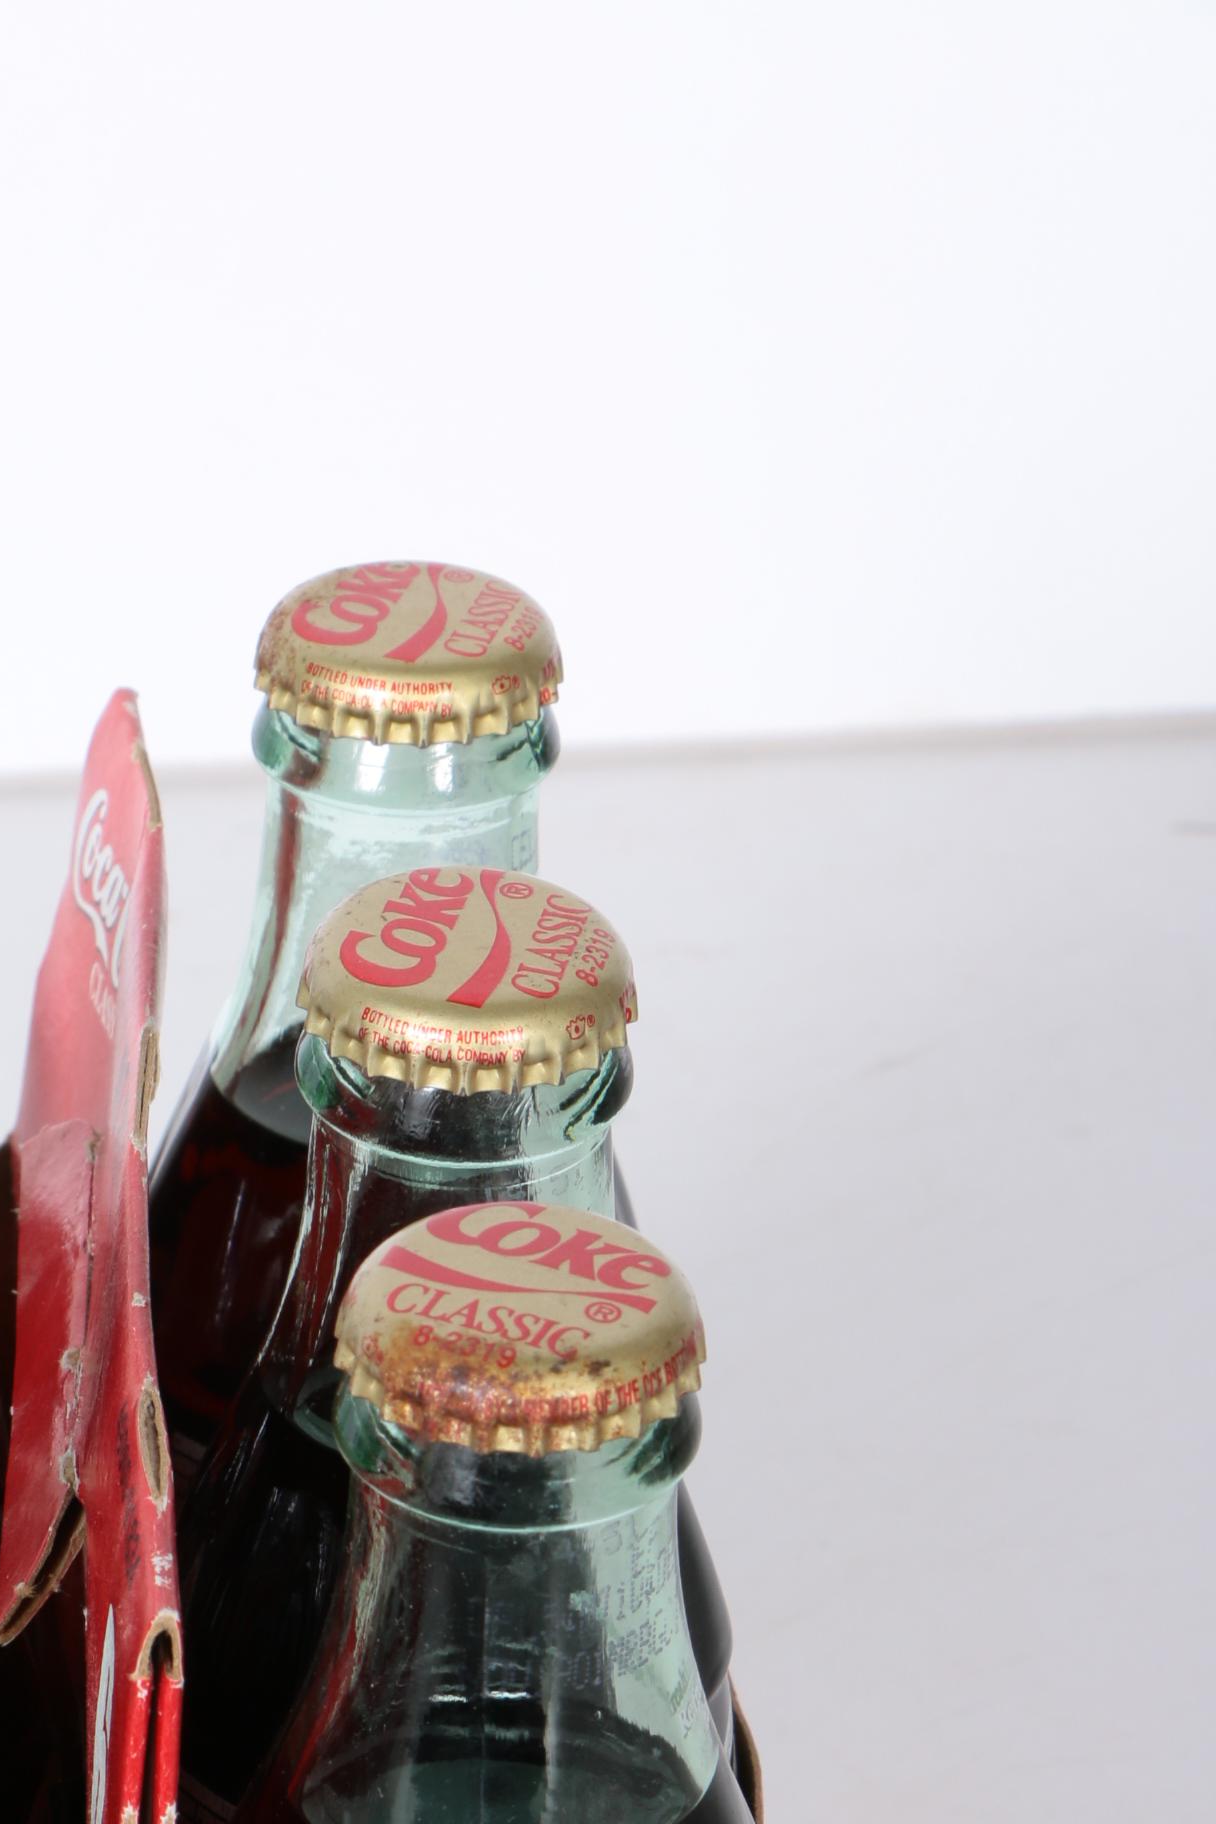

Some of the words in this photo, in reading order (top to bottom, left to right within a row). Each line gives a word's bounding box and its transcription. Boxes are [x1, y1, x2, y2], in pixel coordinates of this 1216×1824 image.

[291, 561, 420, 647] Coke
[444, 580, 524, 657] CLASSIC
[349, 674, 387, 692] UNDER
[390, 680, 453, 696] AUTHORITY
[340, 868, 474, 987] Coke
[511, 894, 593, 1000] CLASSIC
[361, 1006, 409, 1036] BOTTLED
[455, 1025, 525, 1047] AUTHORITY
[426, 1201, 671, 1290] Coke
[387, 1282, 590, 1361] CLASSIC
